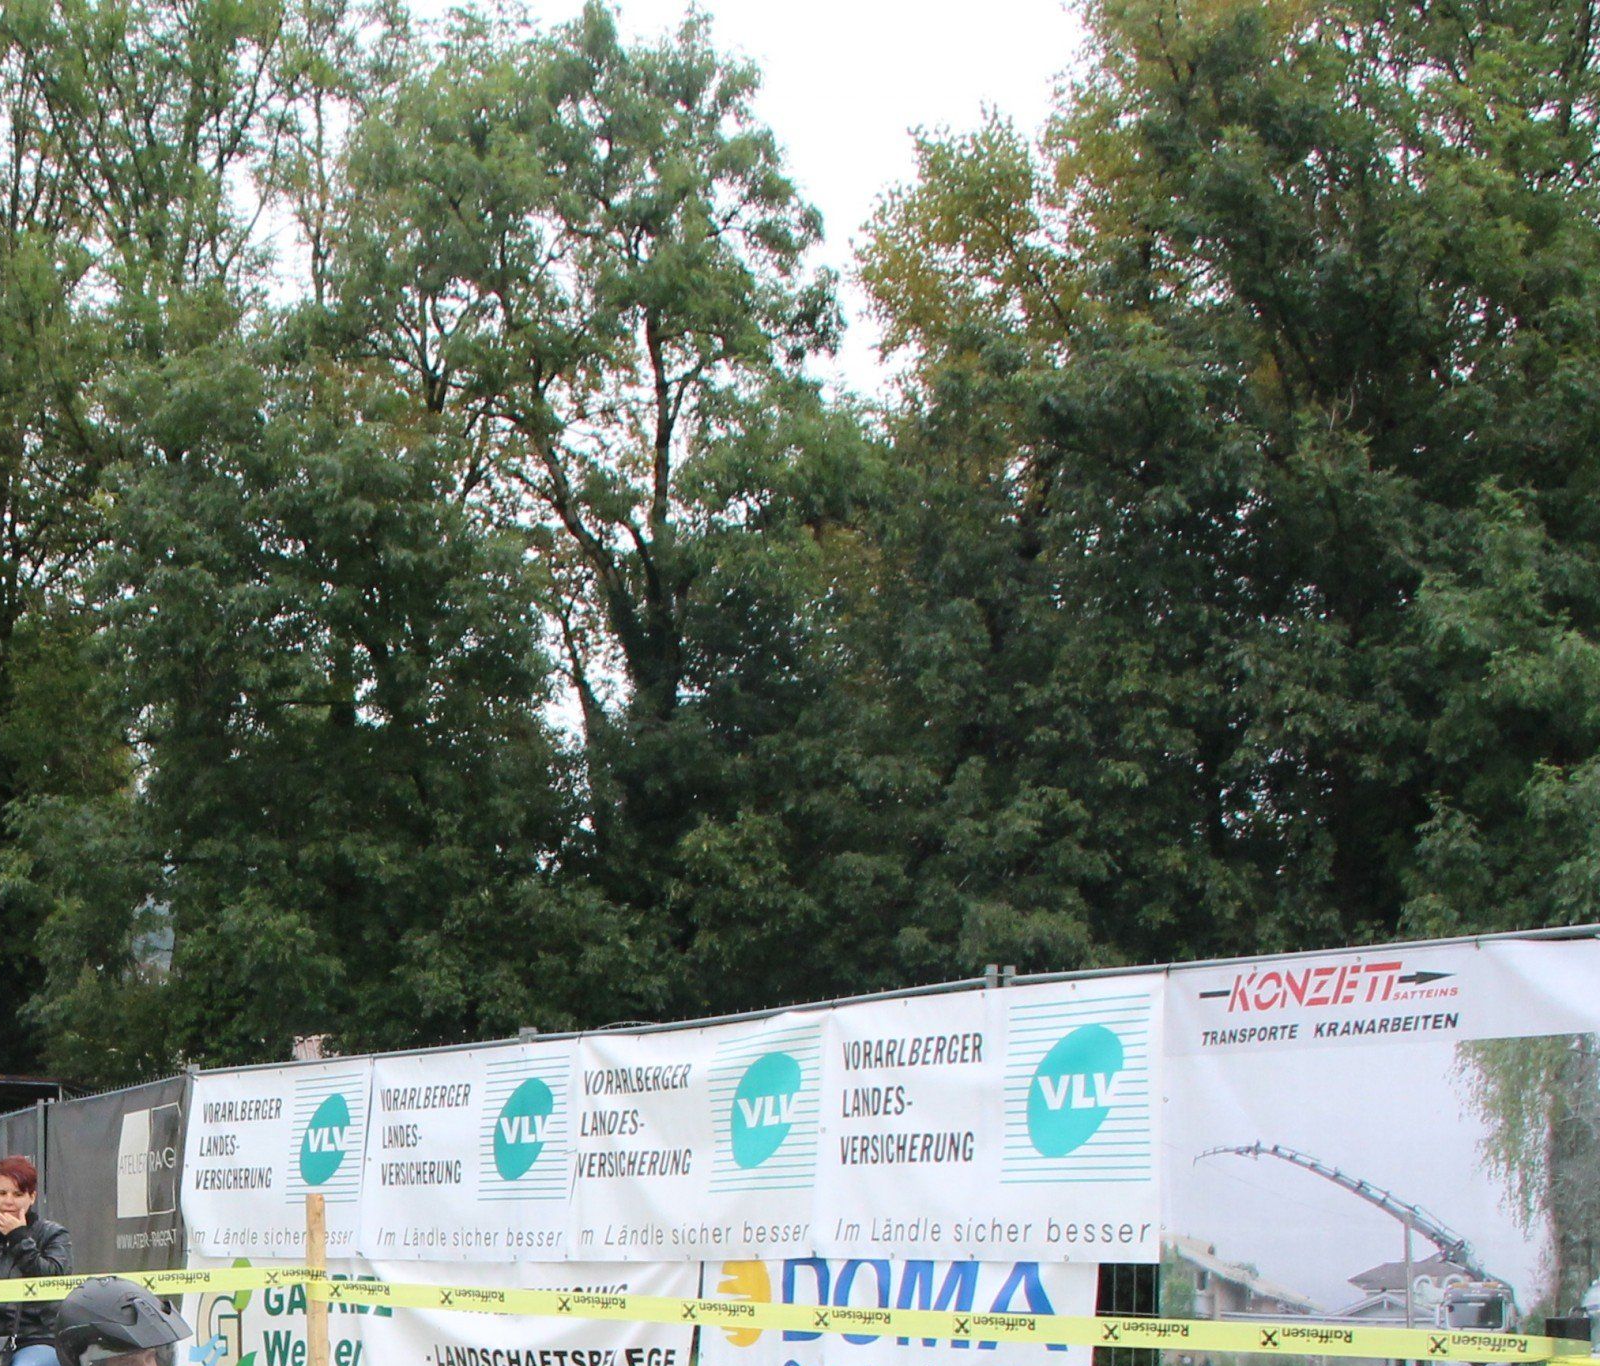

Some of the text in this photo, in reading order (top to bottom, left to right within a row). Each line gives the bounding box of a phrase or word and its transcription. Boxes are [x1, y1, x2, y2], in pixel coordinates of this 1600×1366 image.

[1228, 961, 1402, 1013] KONZETT
[1393, 986, 1459, 1001] SATTEINS
[1202, 1012, 1460, 1046] TRANSPORTE KRANARBEITEN
[842, 1032, 983, 1071] VORARLBERGER
[584, 1063, 692, 1096] VORARLBERGER
[1038, 1071, 1121, 1111] VLV
[380, 1083, 471, 1112] VORARLBERGER
[842, 1086, 913, 1118] LANDES-
[203, 1098, 283, 1124] VORARLBERGER
[580, 1109, 645, 1137] LANDES-
[737, 1093, 800, 1129] VLV
[307, 1126, 351, 1153] VLV
[382, 1123, 423, 1149] LANDES-
[500, 1114, 550, 1144] VLV
[199, 1135, 240, 1157] LANDES-
[840, 1131, 974, 1165] VERSICHERUNG
[381, 1160, 461, 1186] VERSICHERUNG
[577, 1148, 692, 1178] VERSICHERUNG
[195, 1167, 273, 1190] VERSICHERUNG
[214, 1227, 258, 1245] Ländle
[324, 1229, 354, 1246] esser
[377, 1226, 563, 1247] Im Ländle sicher besser
[604, 1224, 664, 1246] Ländle
[672, 1222, 731, 1244] sicher
[742, 1220, 810, 1244] besser
[834, 1217, 1151, 1243] Im Ländle sicher besser
[158, 1271, 210, 1284] Raiffeisen
[343, 1281, 391, 1297] Raiffeisen
[455, 1288, 505, 1304] Raiffeisen
[573, 1295, 626, 1311] Raiffeisen
[699, 1302, 756, 1317] Raiffeisen
[832, 1309, 892, 1325] Raiffeisen
[973, 1315, 1036, 1331] Raiffeisen
[1122, 1321, 1190, 1338] Raiffeisen
[1282, 1328, 1353, 1345] Raiffeisen
[1451, 1334, 1528, 1354] Raiffeisen
